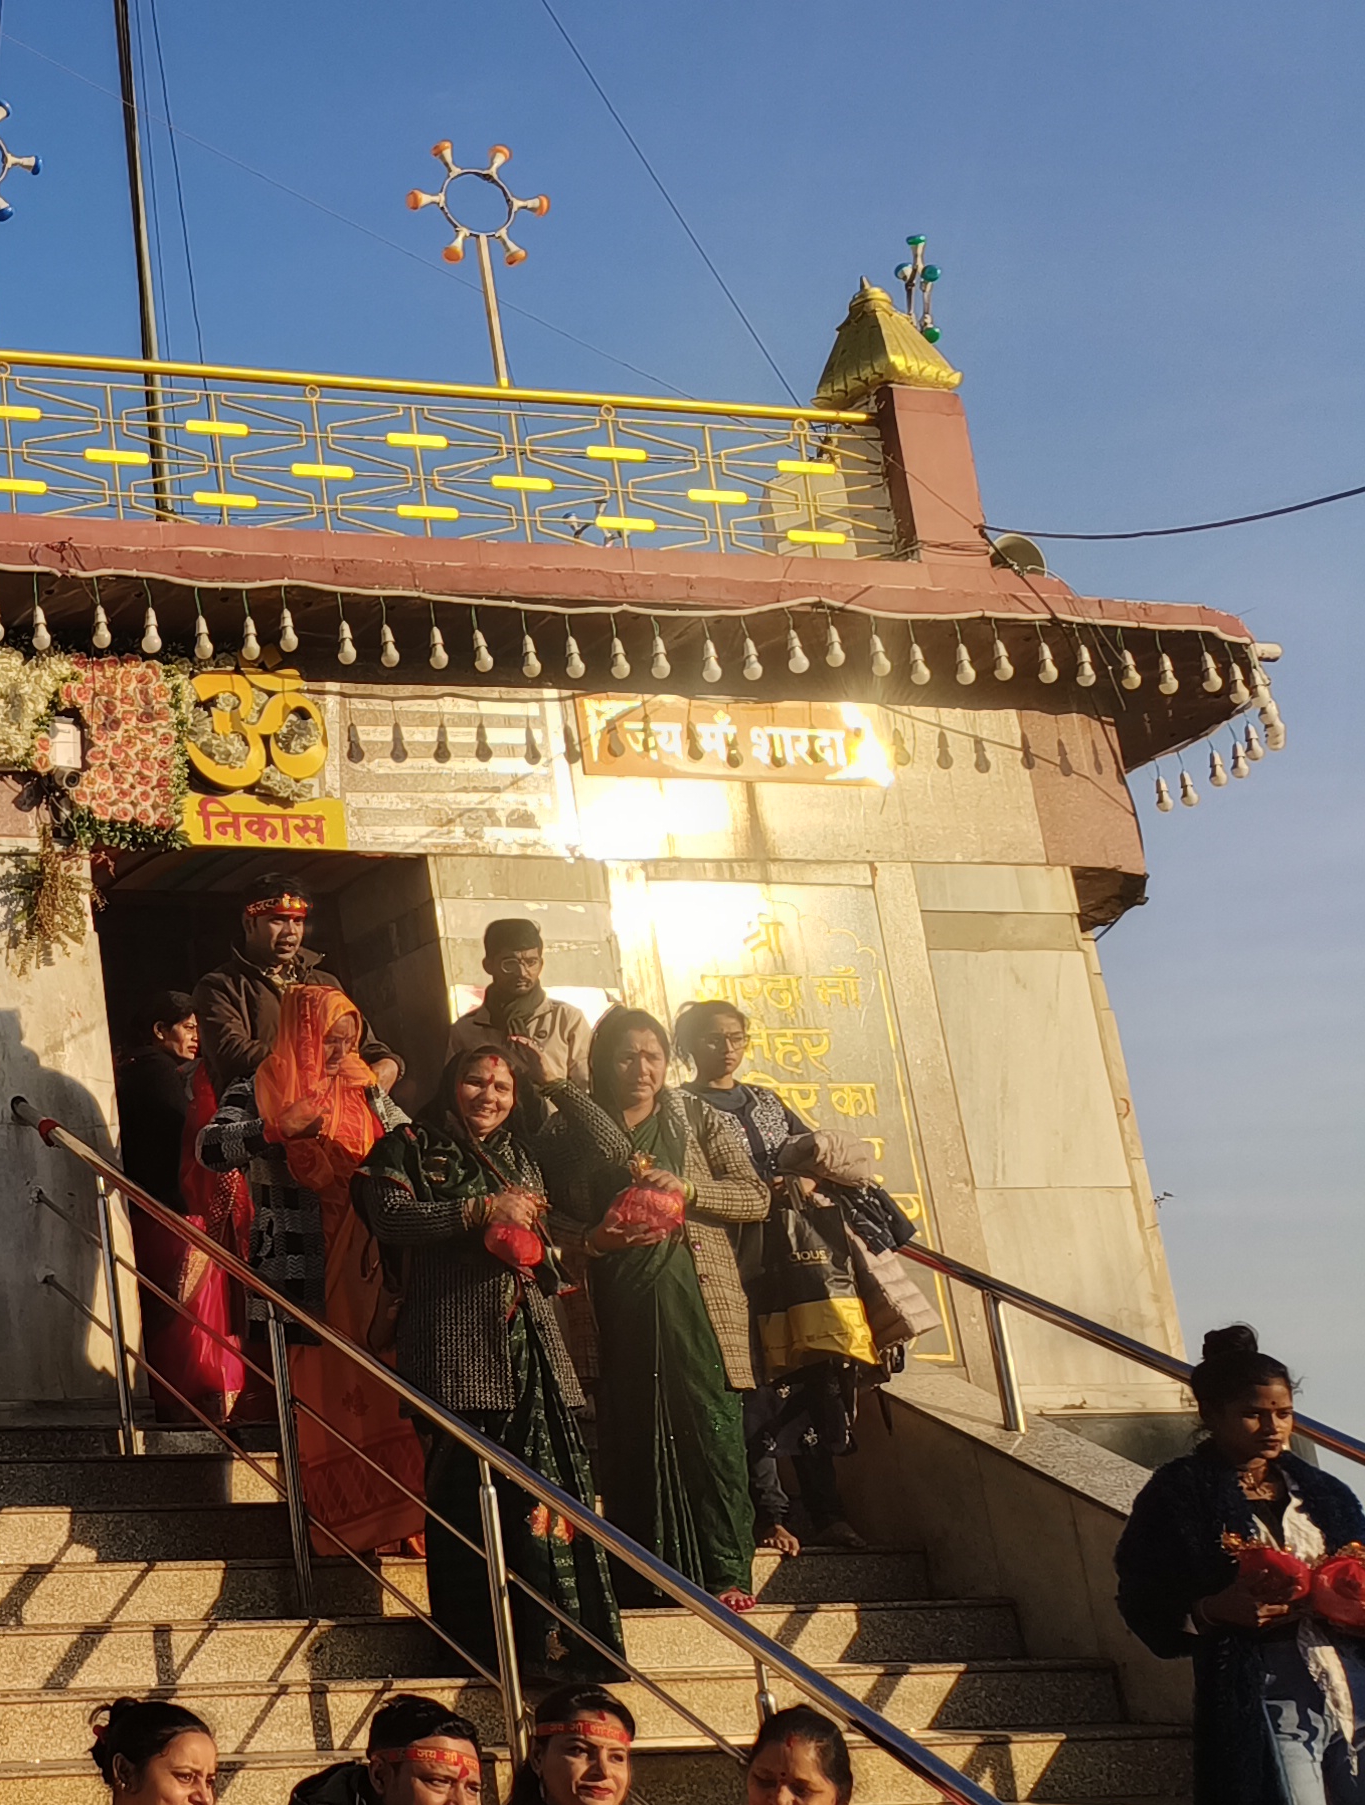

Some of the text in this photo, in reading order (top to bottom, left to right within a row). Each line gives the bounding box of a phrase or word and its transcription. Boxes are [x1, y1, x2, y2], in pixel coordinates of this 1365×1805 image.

[623, 720, 684, 762] जय
[749, 725, 848, 767] शारदा
[195, 797, 327, 845] निकास
